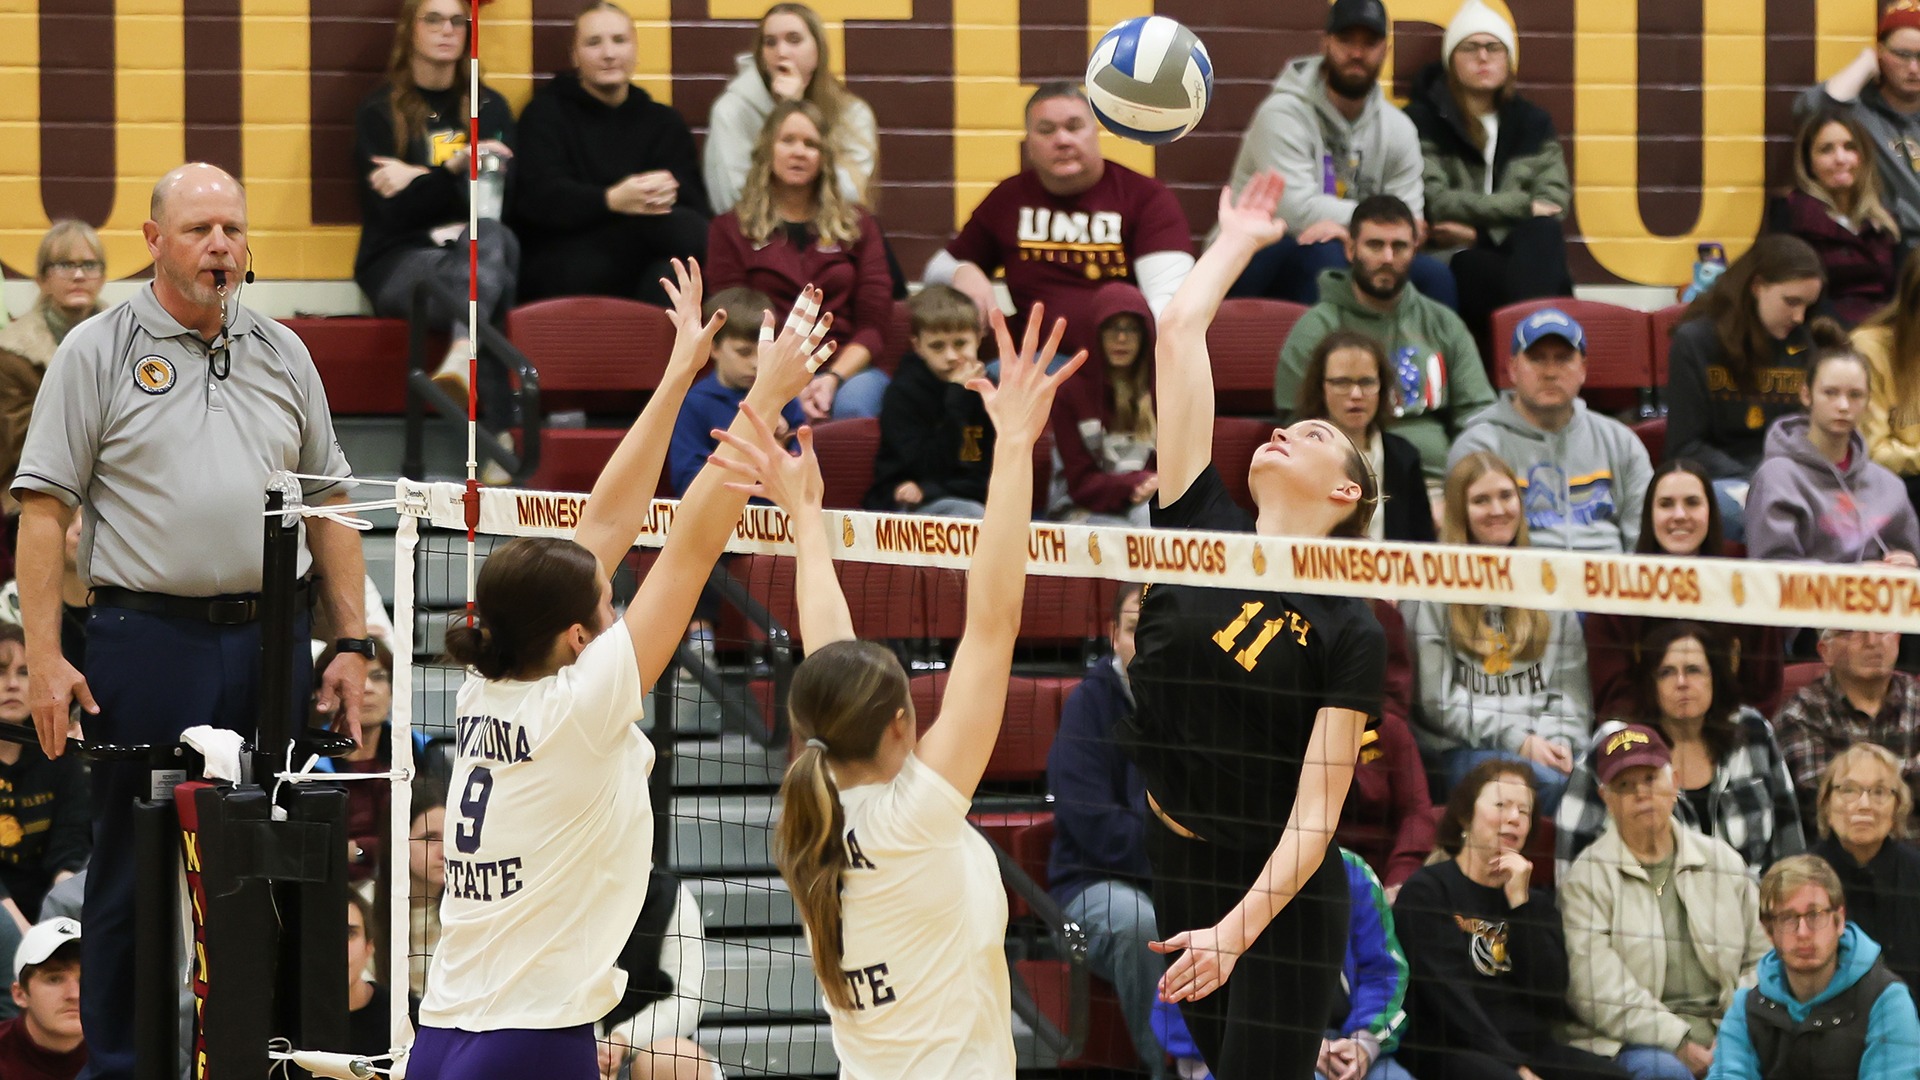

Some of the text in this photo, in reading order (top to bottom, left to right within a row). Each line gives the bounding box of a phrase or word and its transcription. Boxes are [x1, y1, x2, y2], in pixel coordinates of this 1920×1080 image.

[1126, 535, 1227, 574] BULLDOGS
[1291, 545, 1419, 585] MINNESOTA
[1423, 552, 1514, 591] DULUTH
[1584, 560, 1701, 604] BULLDOGS
[1212, 601, 1285, 672] 11
[455, 765, 493, 855] 9
